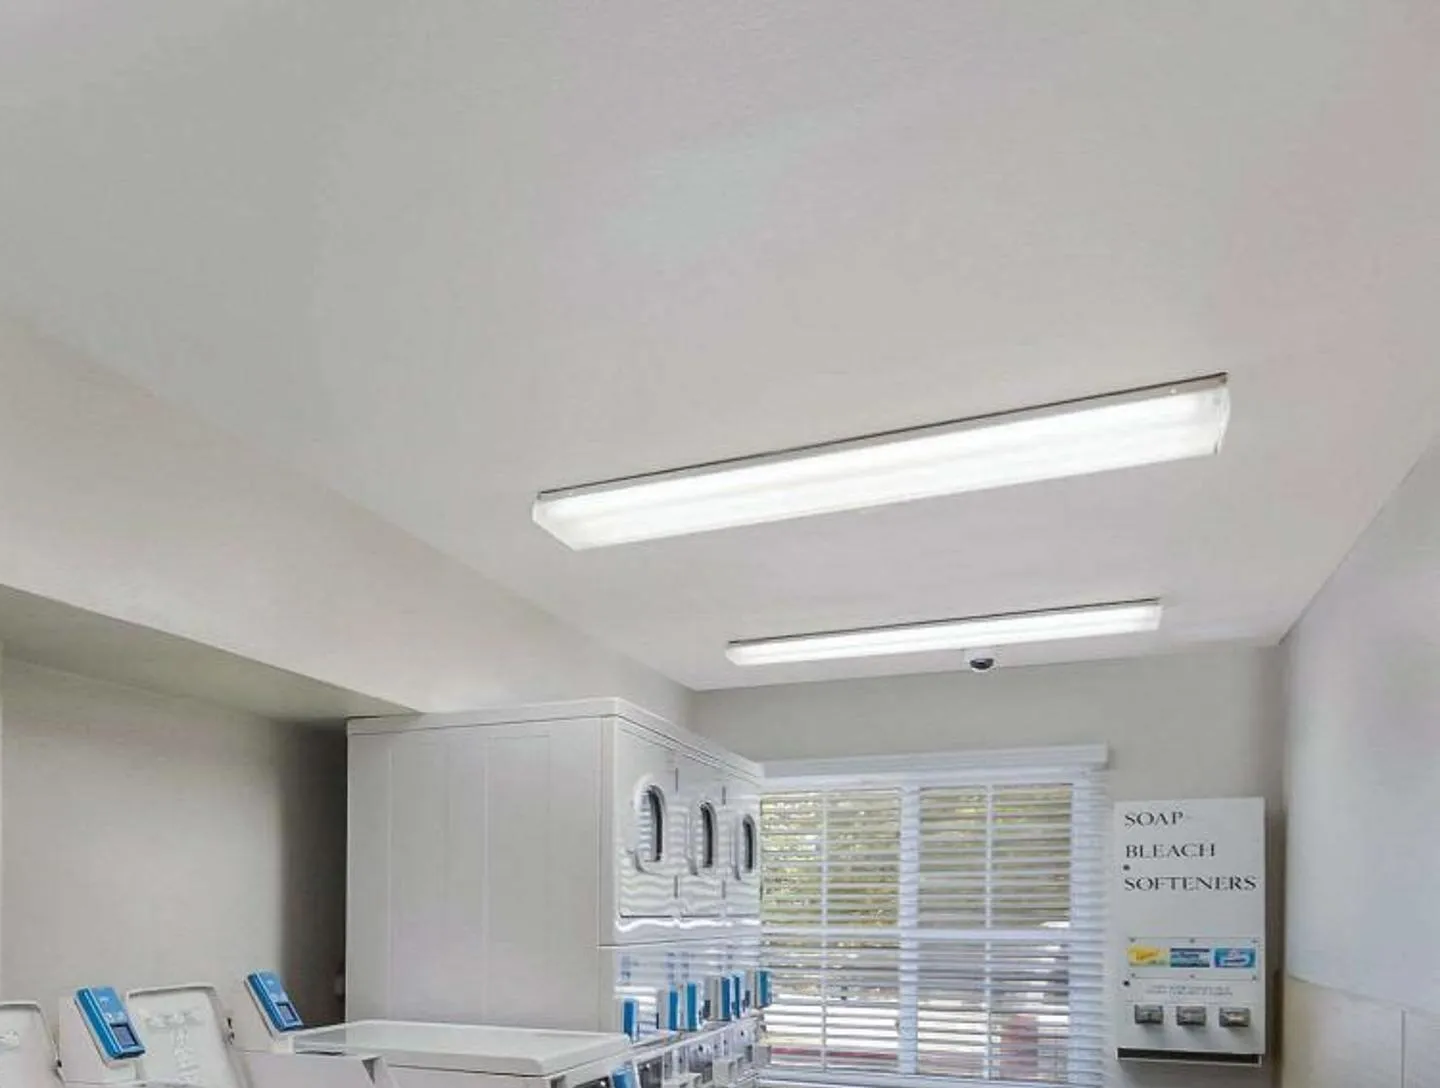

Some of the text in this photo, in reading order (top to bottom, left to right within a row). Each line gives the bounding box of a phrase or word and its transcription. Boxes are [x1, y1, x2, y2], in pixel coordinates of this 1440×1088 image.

[1124, 811, 1184, 827] SOAP
[1125, 843, 1216, 859] BLEACH
[1124, 875, 1257, 891] SOFTENERS
